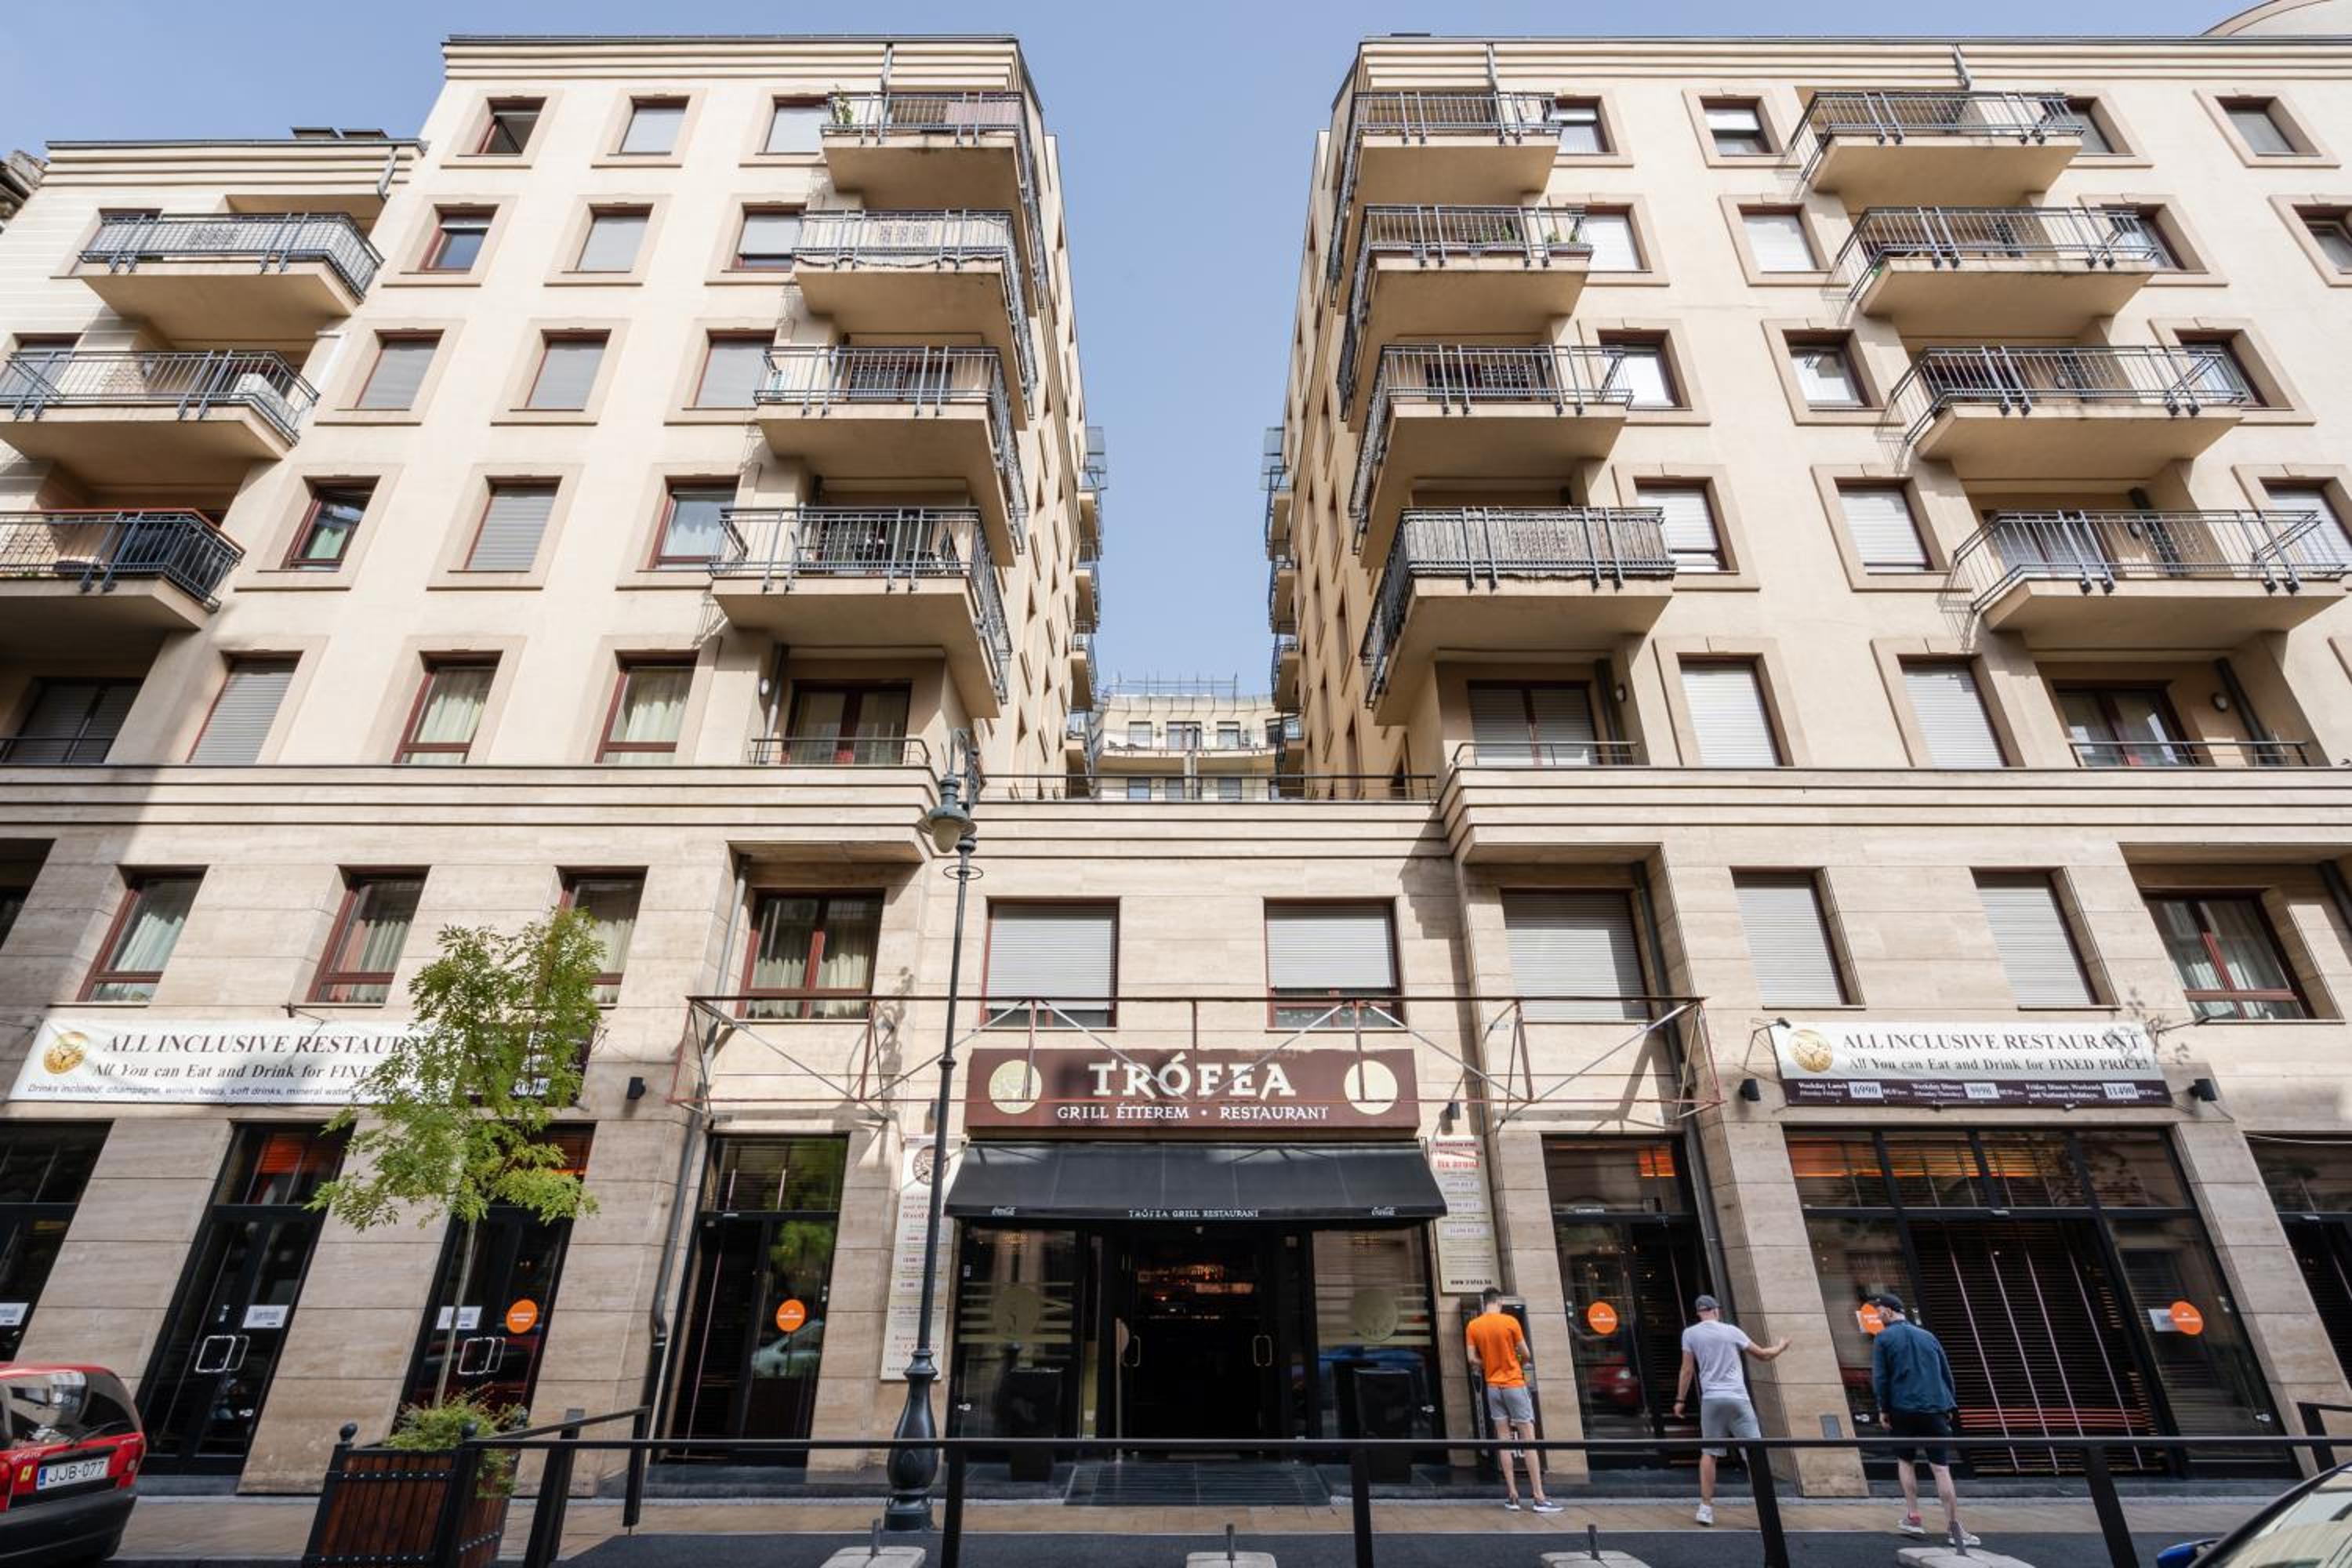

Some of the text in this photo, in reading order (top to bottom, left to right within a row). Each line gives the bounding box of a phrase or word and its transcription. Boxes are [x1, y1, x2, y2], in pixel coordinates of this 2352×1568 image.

[103, 1033, 412, 1054] ALL INCLUSIVE RESTAUR
[1843, 1033, 2140, 1051] ALL INCLUSIVE RESTAURANT
[93, 1063, 114, 1078] All
[122, 1063, 149, 1078] You
[154, 1066, 180, 1078] can
[186, 1063, 212, 1078] Eat
[216, 1064, 248, 1078] and
[251, 1063, 296, 1079] Drink
[300, 1063, 325, 1079] for
[329, 1065, 376, 1080] FIXE
[1849, 1058, 2151, 1072] All You can Eat and Drink for FIXED PRICE!
[1088, 1051, 1297, 1101] TRÓFEA
[27, 1083, 58, 1093] Drinks
[230, 1087, 249, 1096] soft
[286, 1087, 323, 1096] mineral
[1058, 1102, 1329, 1120] GRILL ÉTTEREM RESTAURANT
[48, 1461, 106, 1483] JJB-077
